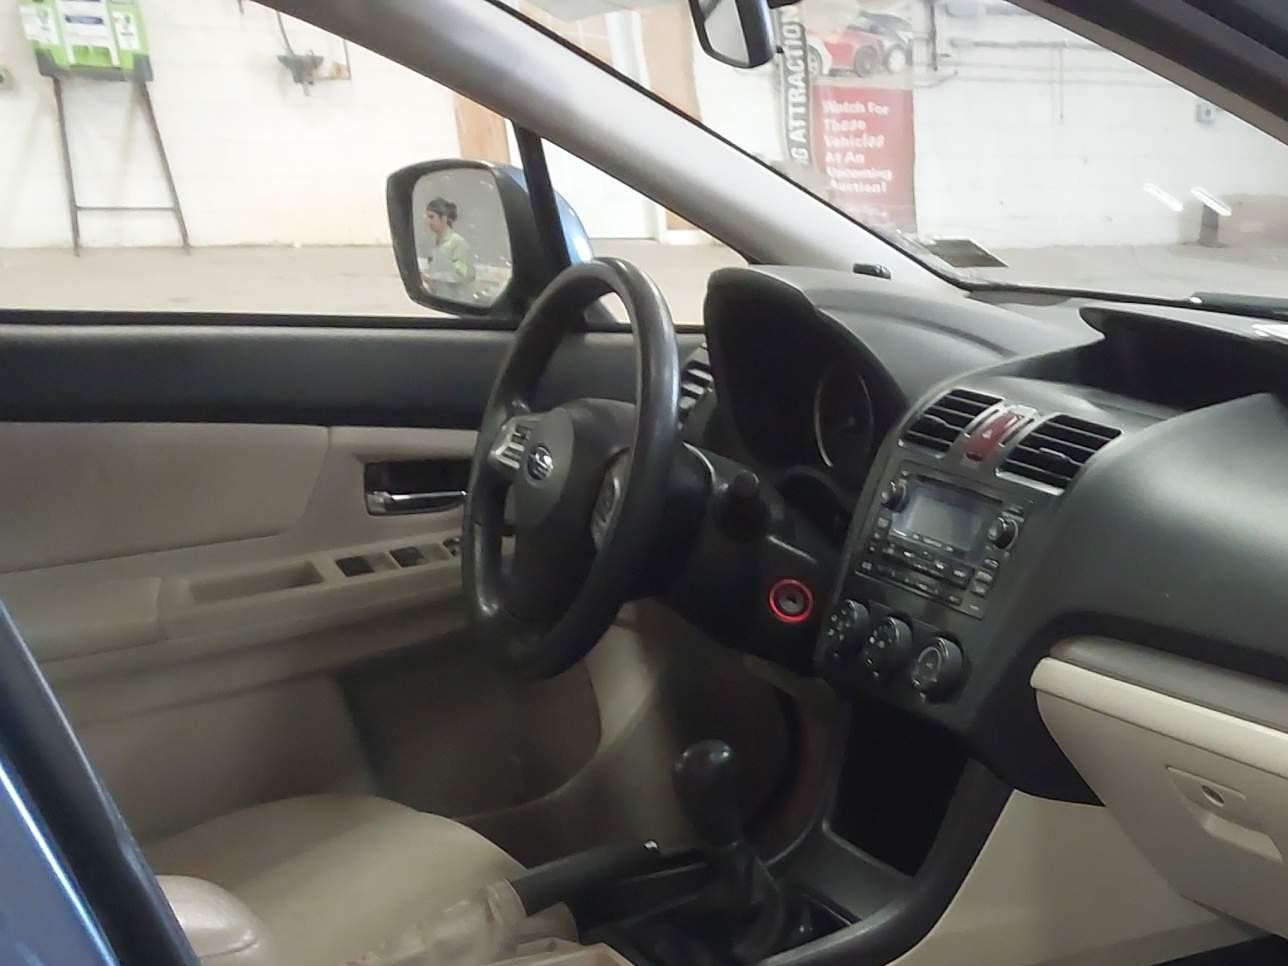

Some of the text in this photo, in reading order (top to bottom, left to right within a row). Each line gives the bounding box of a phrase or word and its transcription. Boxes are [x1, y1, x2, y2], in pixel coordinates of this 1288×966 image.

[868, 101, 889, 115] For
[823, 118, 866, 132] These
[823, 133, 885, 148] Vehicles
[844, 151, 865, 163] An
